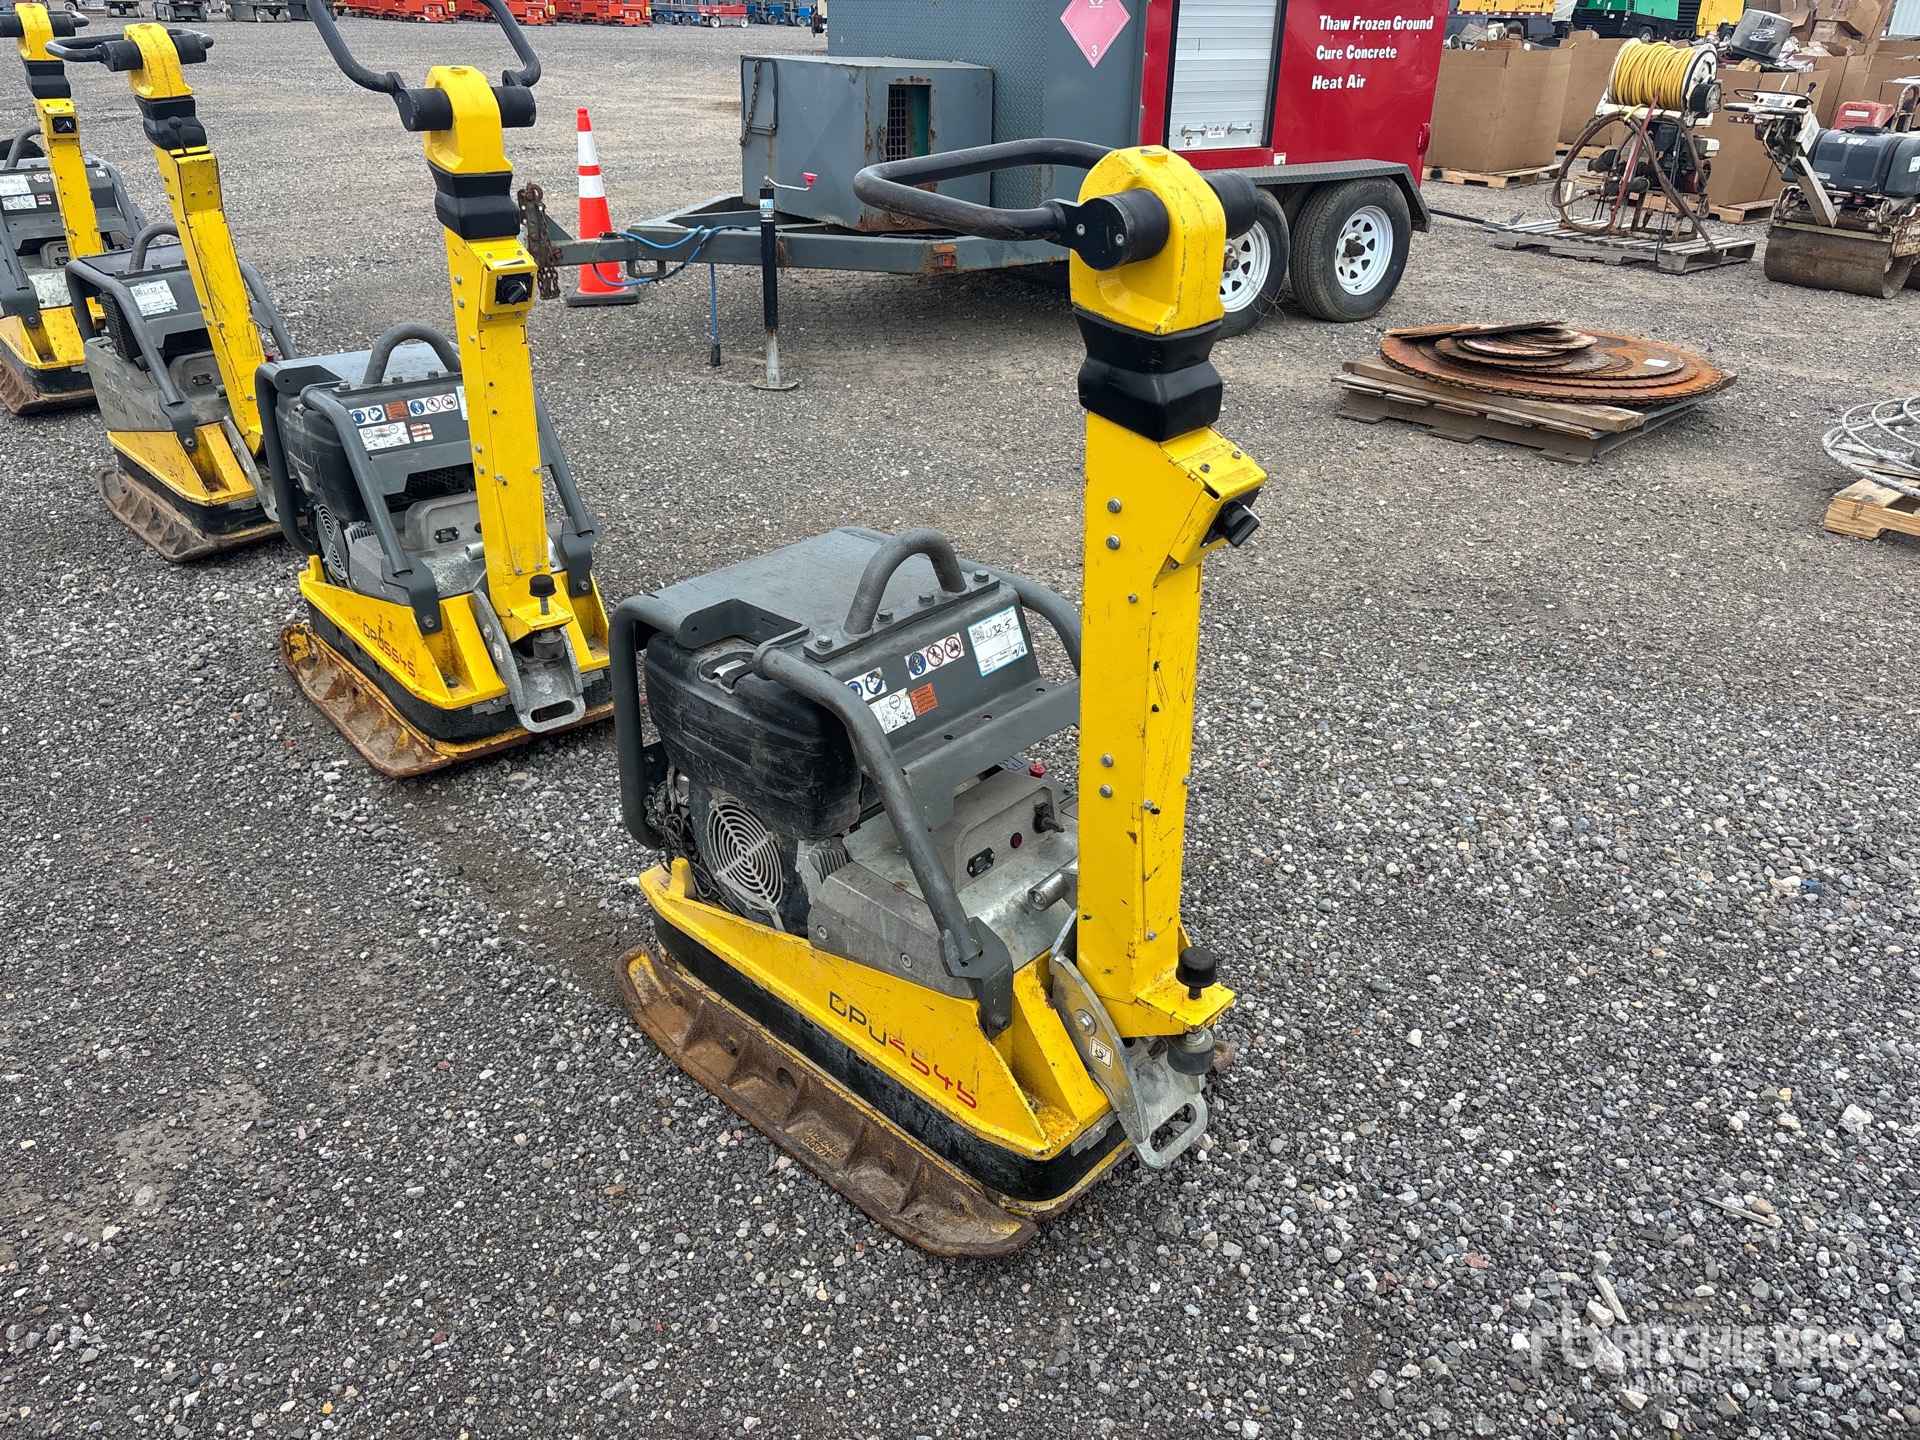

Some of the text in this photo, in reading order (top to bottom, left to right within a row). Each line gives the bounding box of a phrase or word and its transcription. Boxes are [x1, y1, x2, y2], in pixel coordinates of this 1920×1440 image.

[1319, 15, 1434, 31] Thaw Frozen Ground
[1090, 44, 1098, 57] 3
[1316, 44, 1397, 60] Cure Concrete
[1311, 73, 1366, 90] Heat Air
[363, 621, 416, 678] DPU5545
